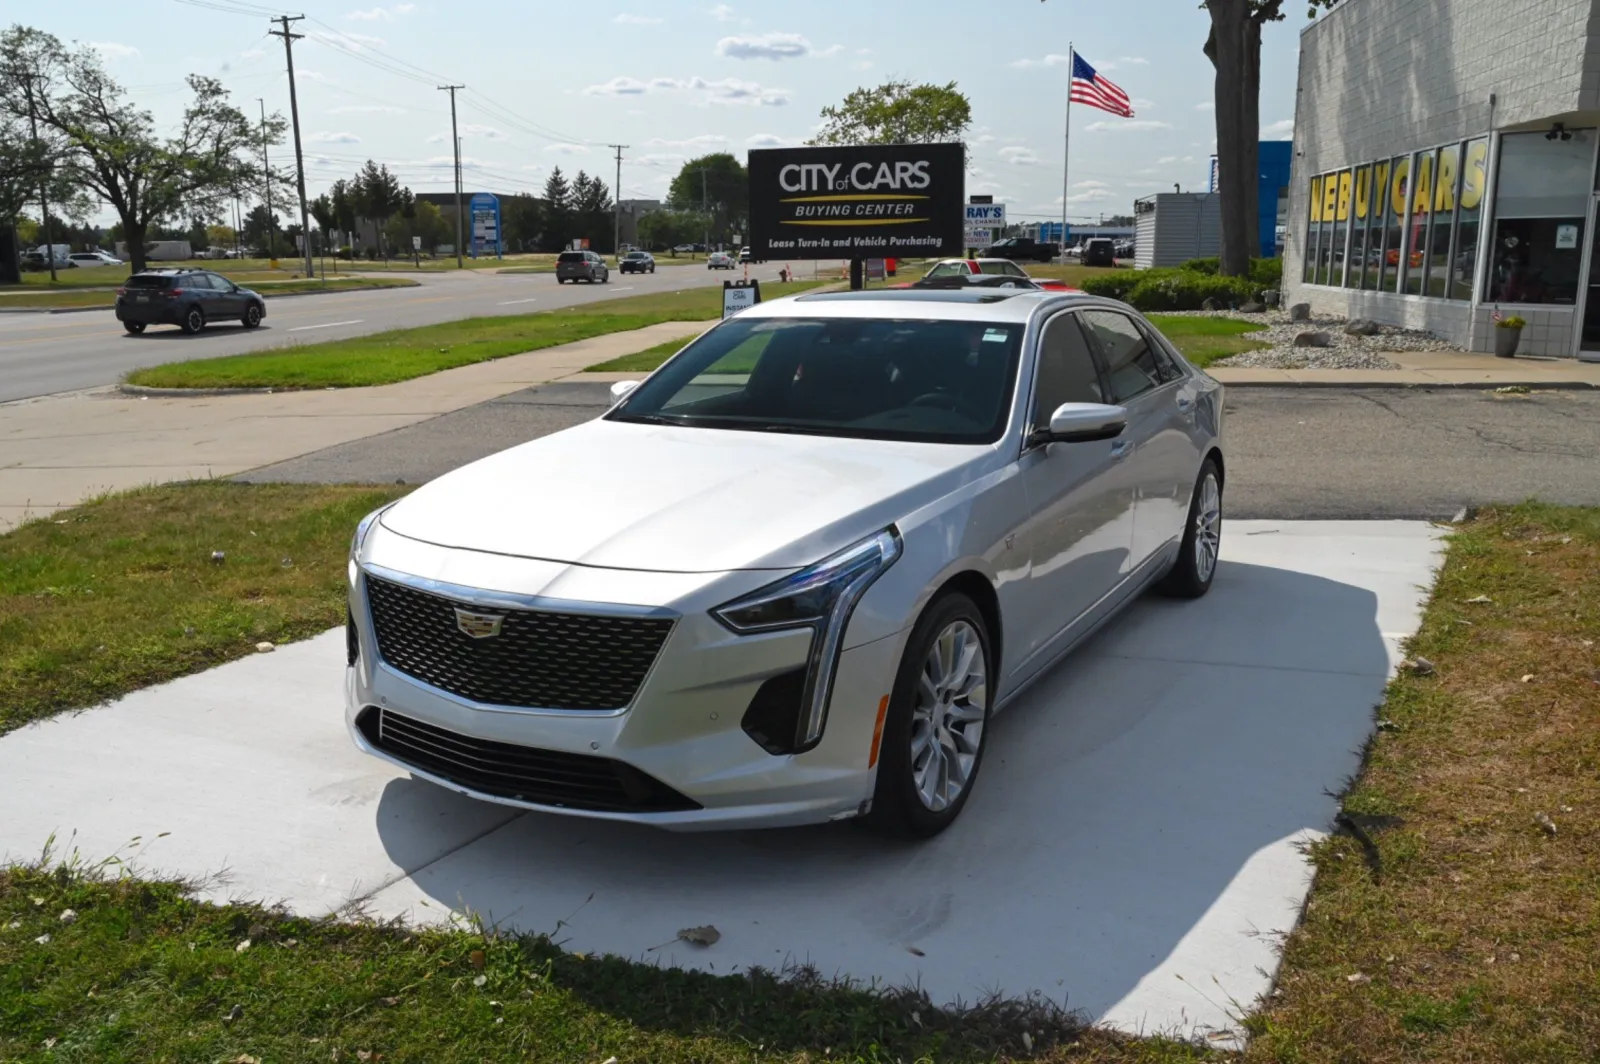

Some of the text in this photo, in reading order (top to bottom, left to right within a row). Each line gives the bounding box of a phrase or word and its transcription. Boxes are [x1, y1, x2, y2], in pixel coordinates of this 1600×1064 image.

[779, 160, 931, 192] CITY of CARS
[795, 203, 914, 217] BUYING CENTER
[966, 207, 1001, 218] RAY'S
[768, 235, 942, 248] Lease Turn-In and Vehicle Purchasing
